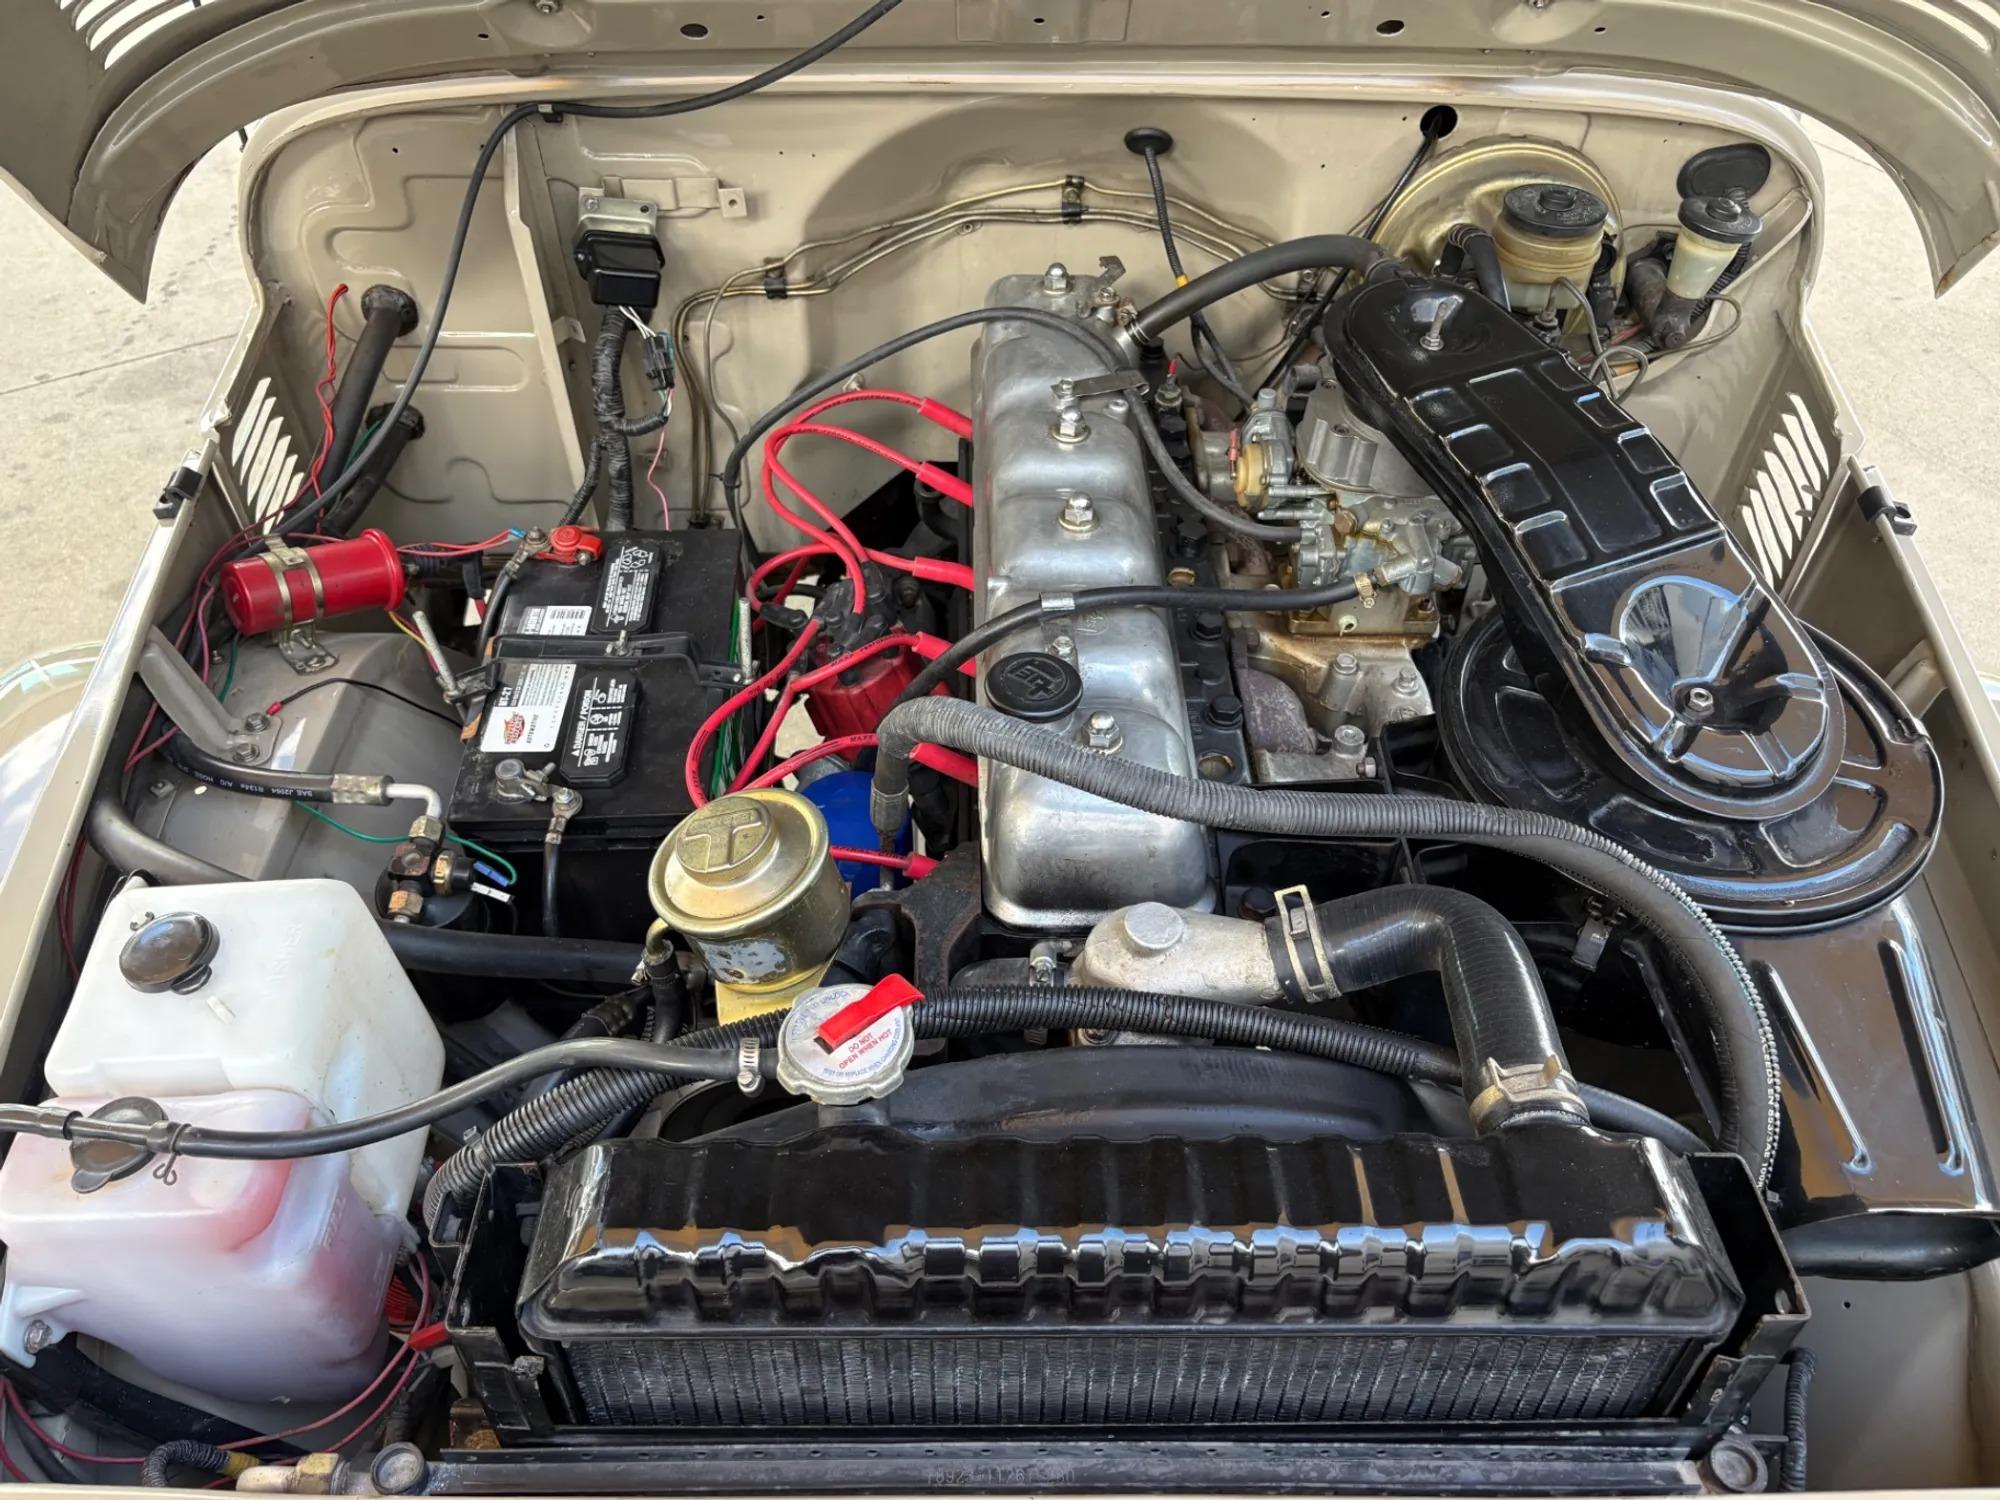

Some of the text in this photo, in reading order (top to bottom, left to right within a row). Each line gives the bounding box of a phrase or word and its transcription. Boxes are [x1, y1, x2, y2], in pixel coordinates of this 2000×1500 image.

[573, 720, 586, 749] DANGER
[580, 690, 593, 715] POISON
[297, 788, 313, 797] SAE
[838, 1028, 892, 1070] OPEN WHEN HOT
[848, 1032, 873, 1054] DO NOT
[1757, 1028, 1774, 1085] EXCEEDS
[1767, 1088, 1774, 1105] EN
